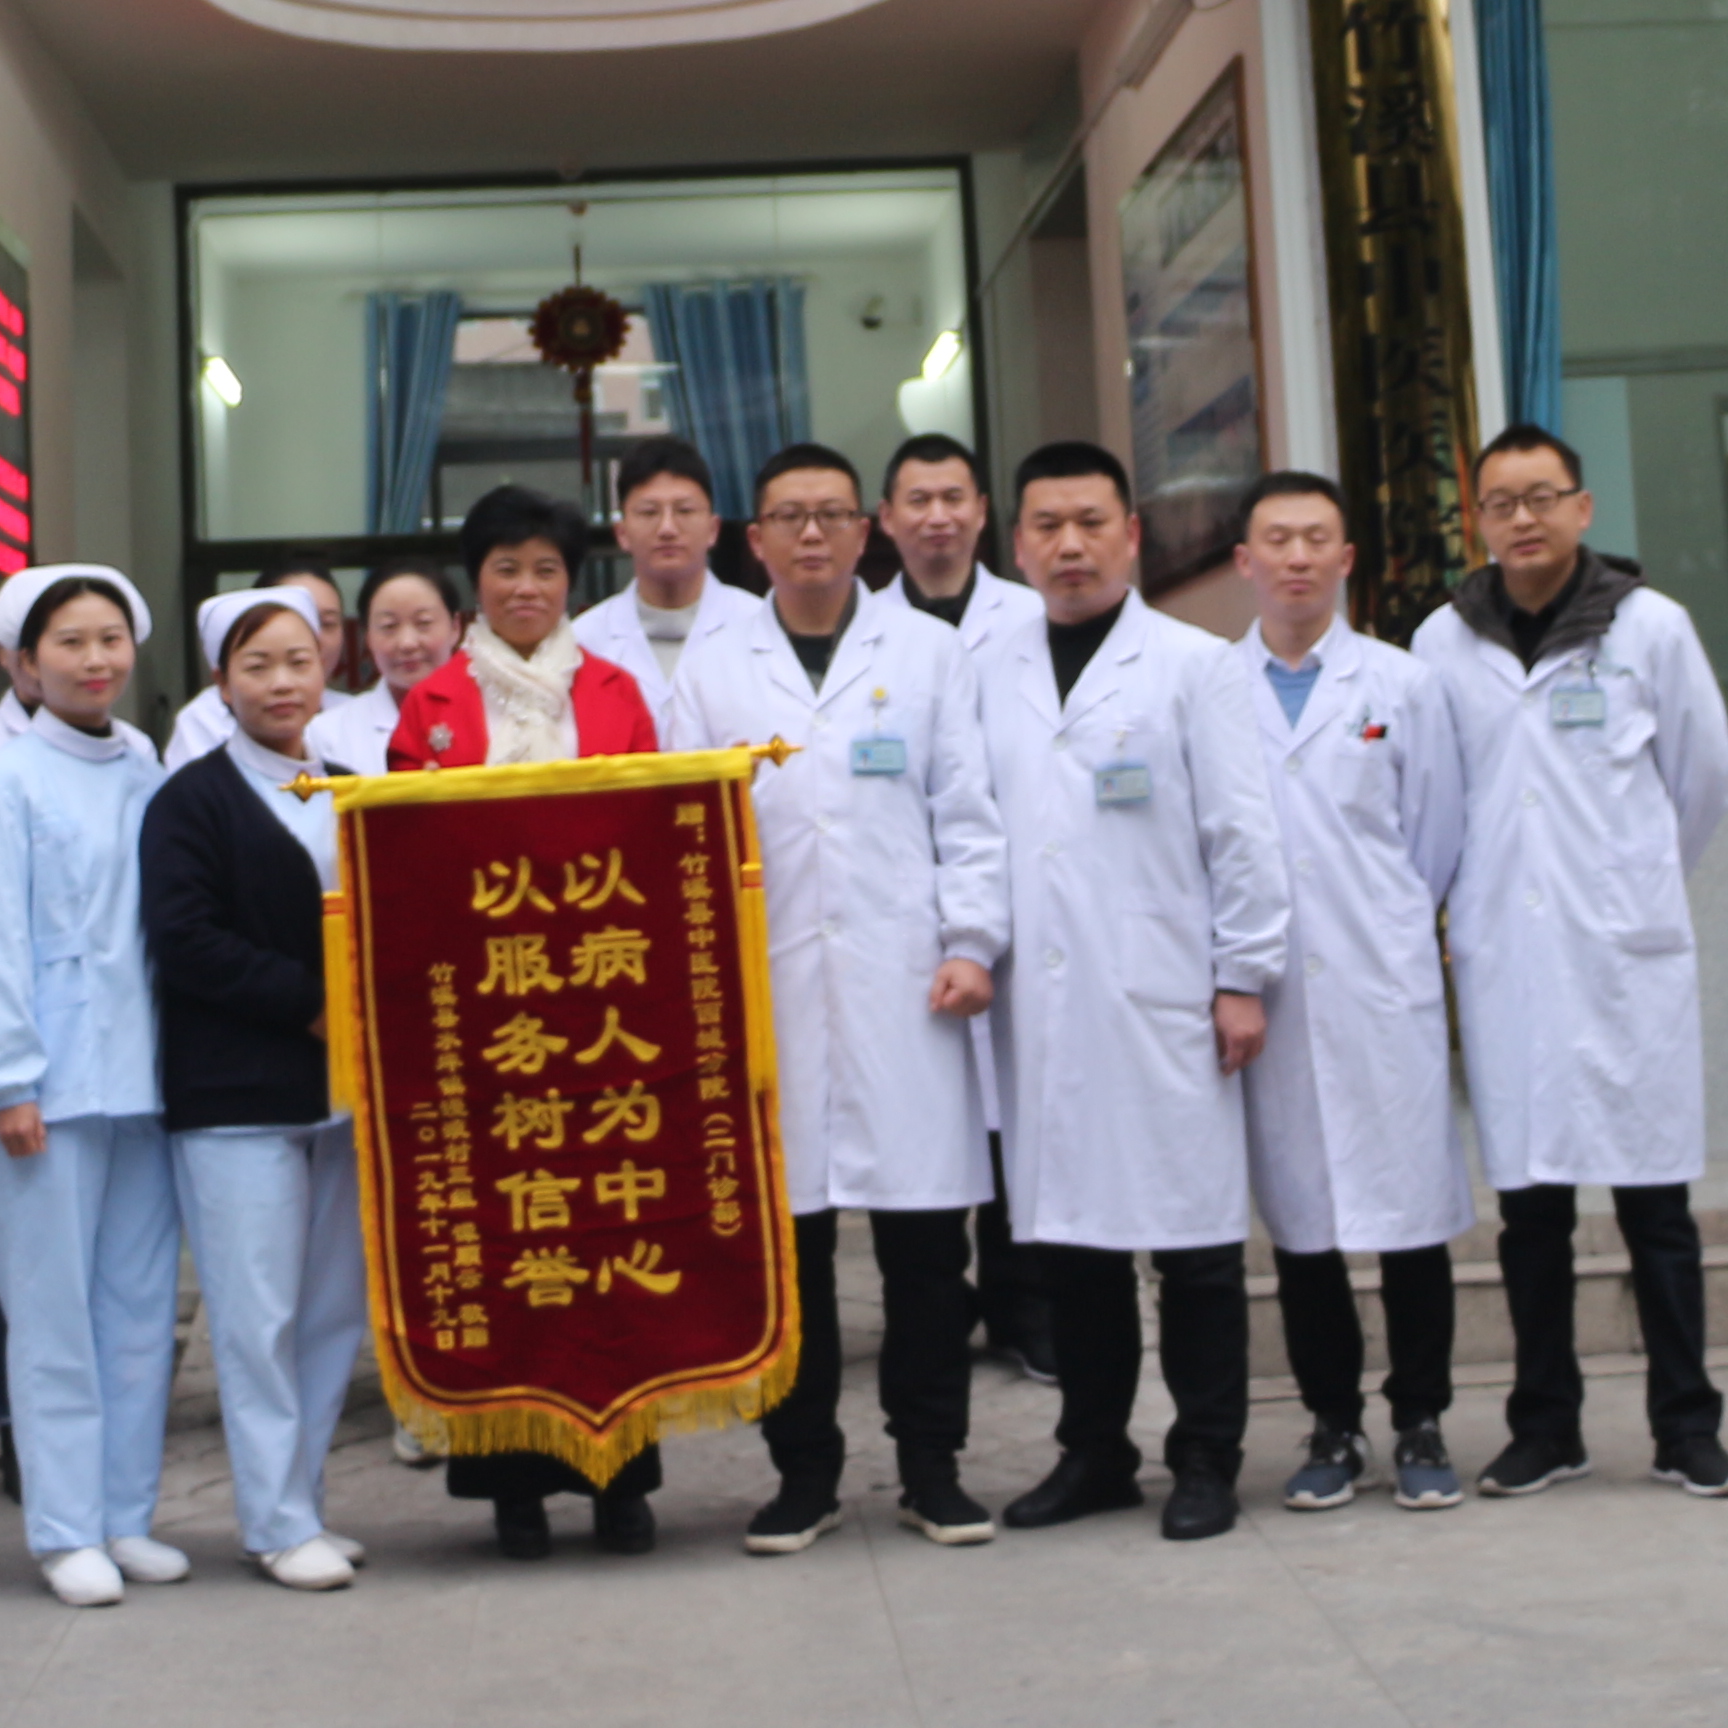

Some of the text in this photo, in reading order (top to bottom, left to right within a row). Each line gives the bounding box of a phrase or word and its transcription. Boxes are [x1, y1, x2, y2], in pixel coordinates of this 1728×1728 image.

[471, 855, 590, 1309] 以服务树信誉
[563, 848, 682, 1296] 以病人为中心
